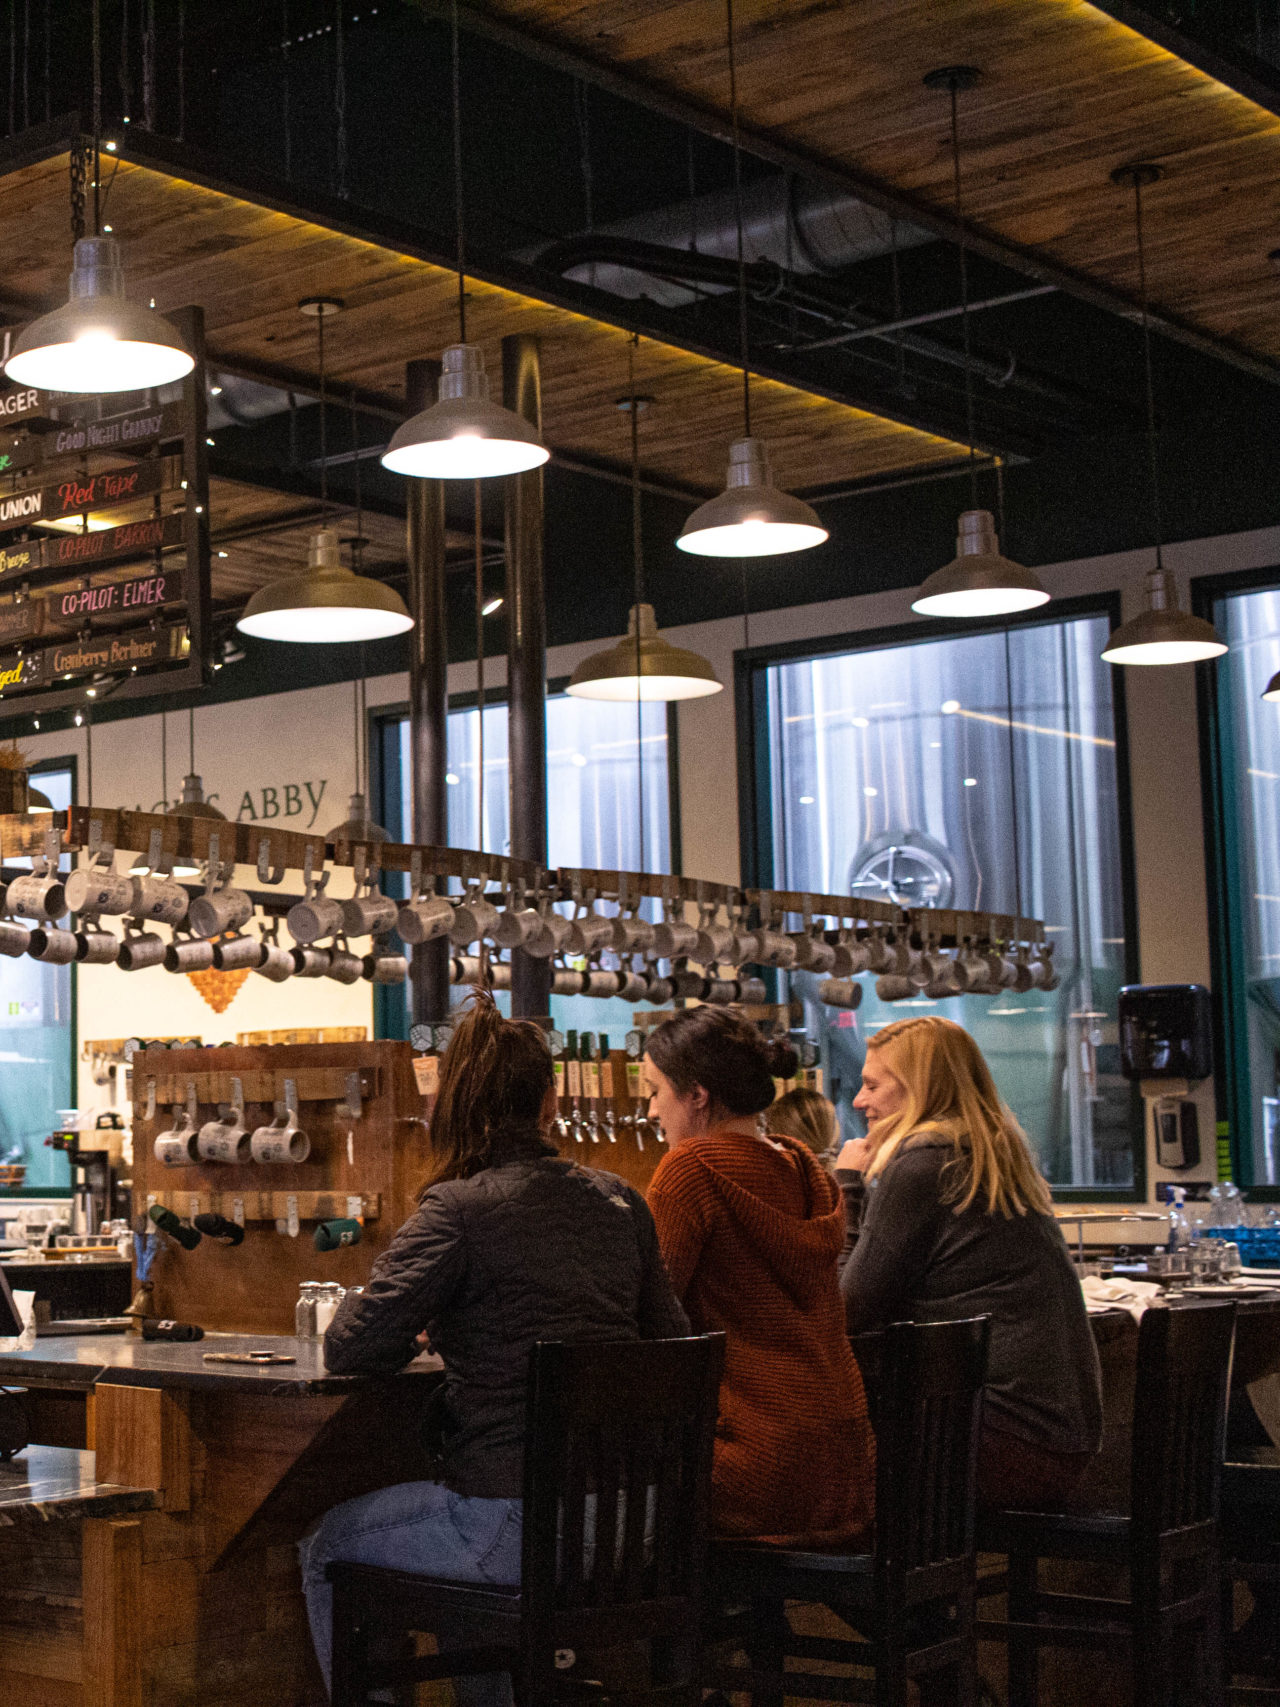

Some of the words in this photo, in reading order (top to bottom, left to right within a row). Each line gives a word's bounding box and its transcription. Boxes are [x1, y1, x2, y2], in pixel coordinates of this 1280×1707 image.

[0, 493, 42, 521] UNION
[58, 478, 96, 511] Red
[98, 472, 139, 499] Tape
[62, 585, 119, 615] CO-PILOT:
[122, 577, 167, 607] ELMER
[235, 780, 328, 829] ABBY
